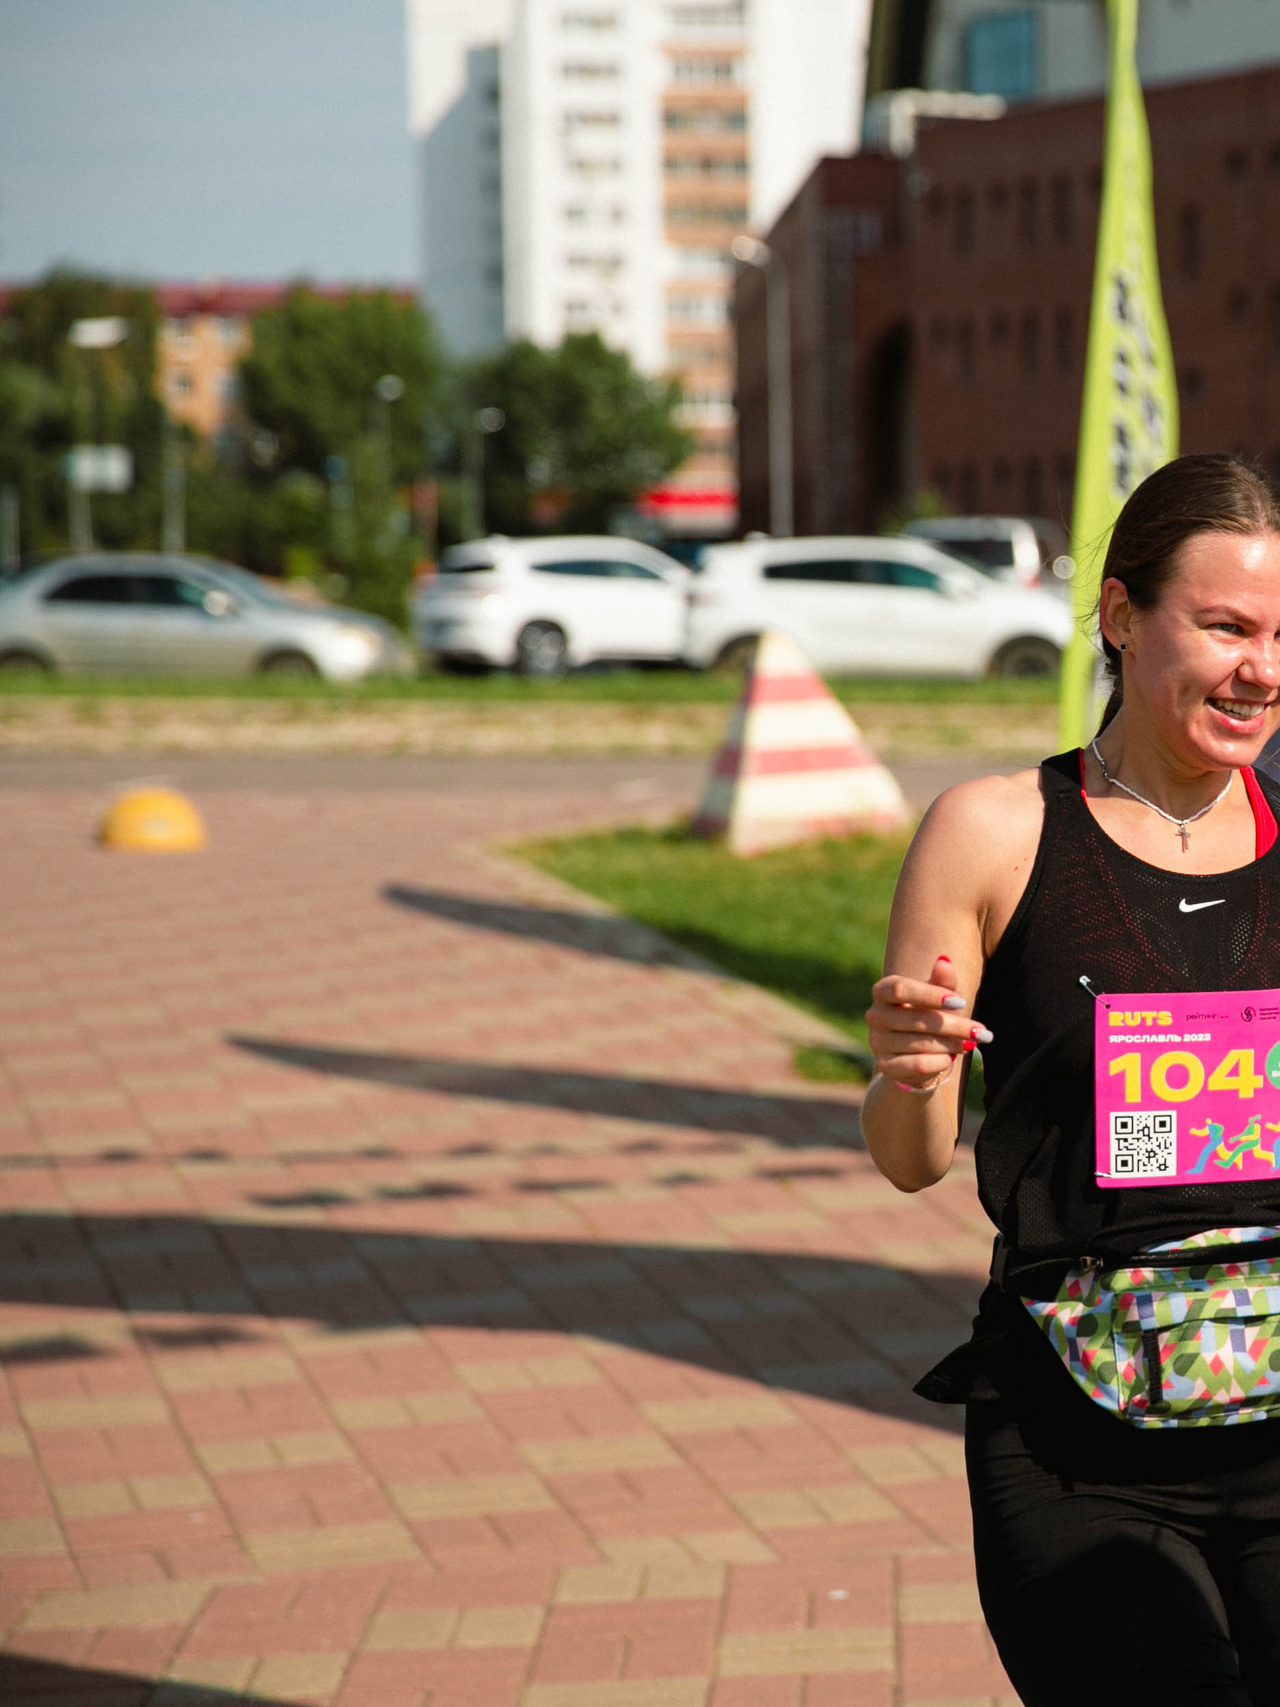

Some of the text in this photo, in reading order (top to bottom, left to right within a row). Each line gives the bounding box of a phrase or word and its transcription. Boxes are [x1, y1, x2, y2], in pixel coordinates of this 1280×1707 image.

[1108, 1010, 1173, 1027] RUTS
[1109, 1032, 1211, 1043] ЯРОСЛАВЛЬ 2023
[1109, 1048, 1264, 1104] 104
